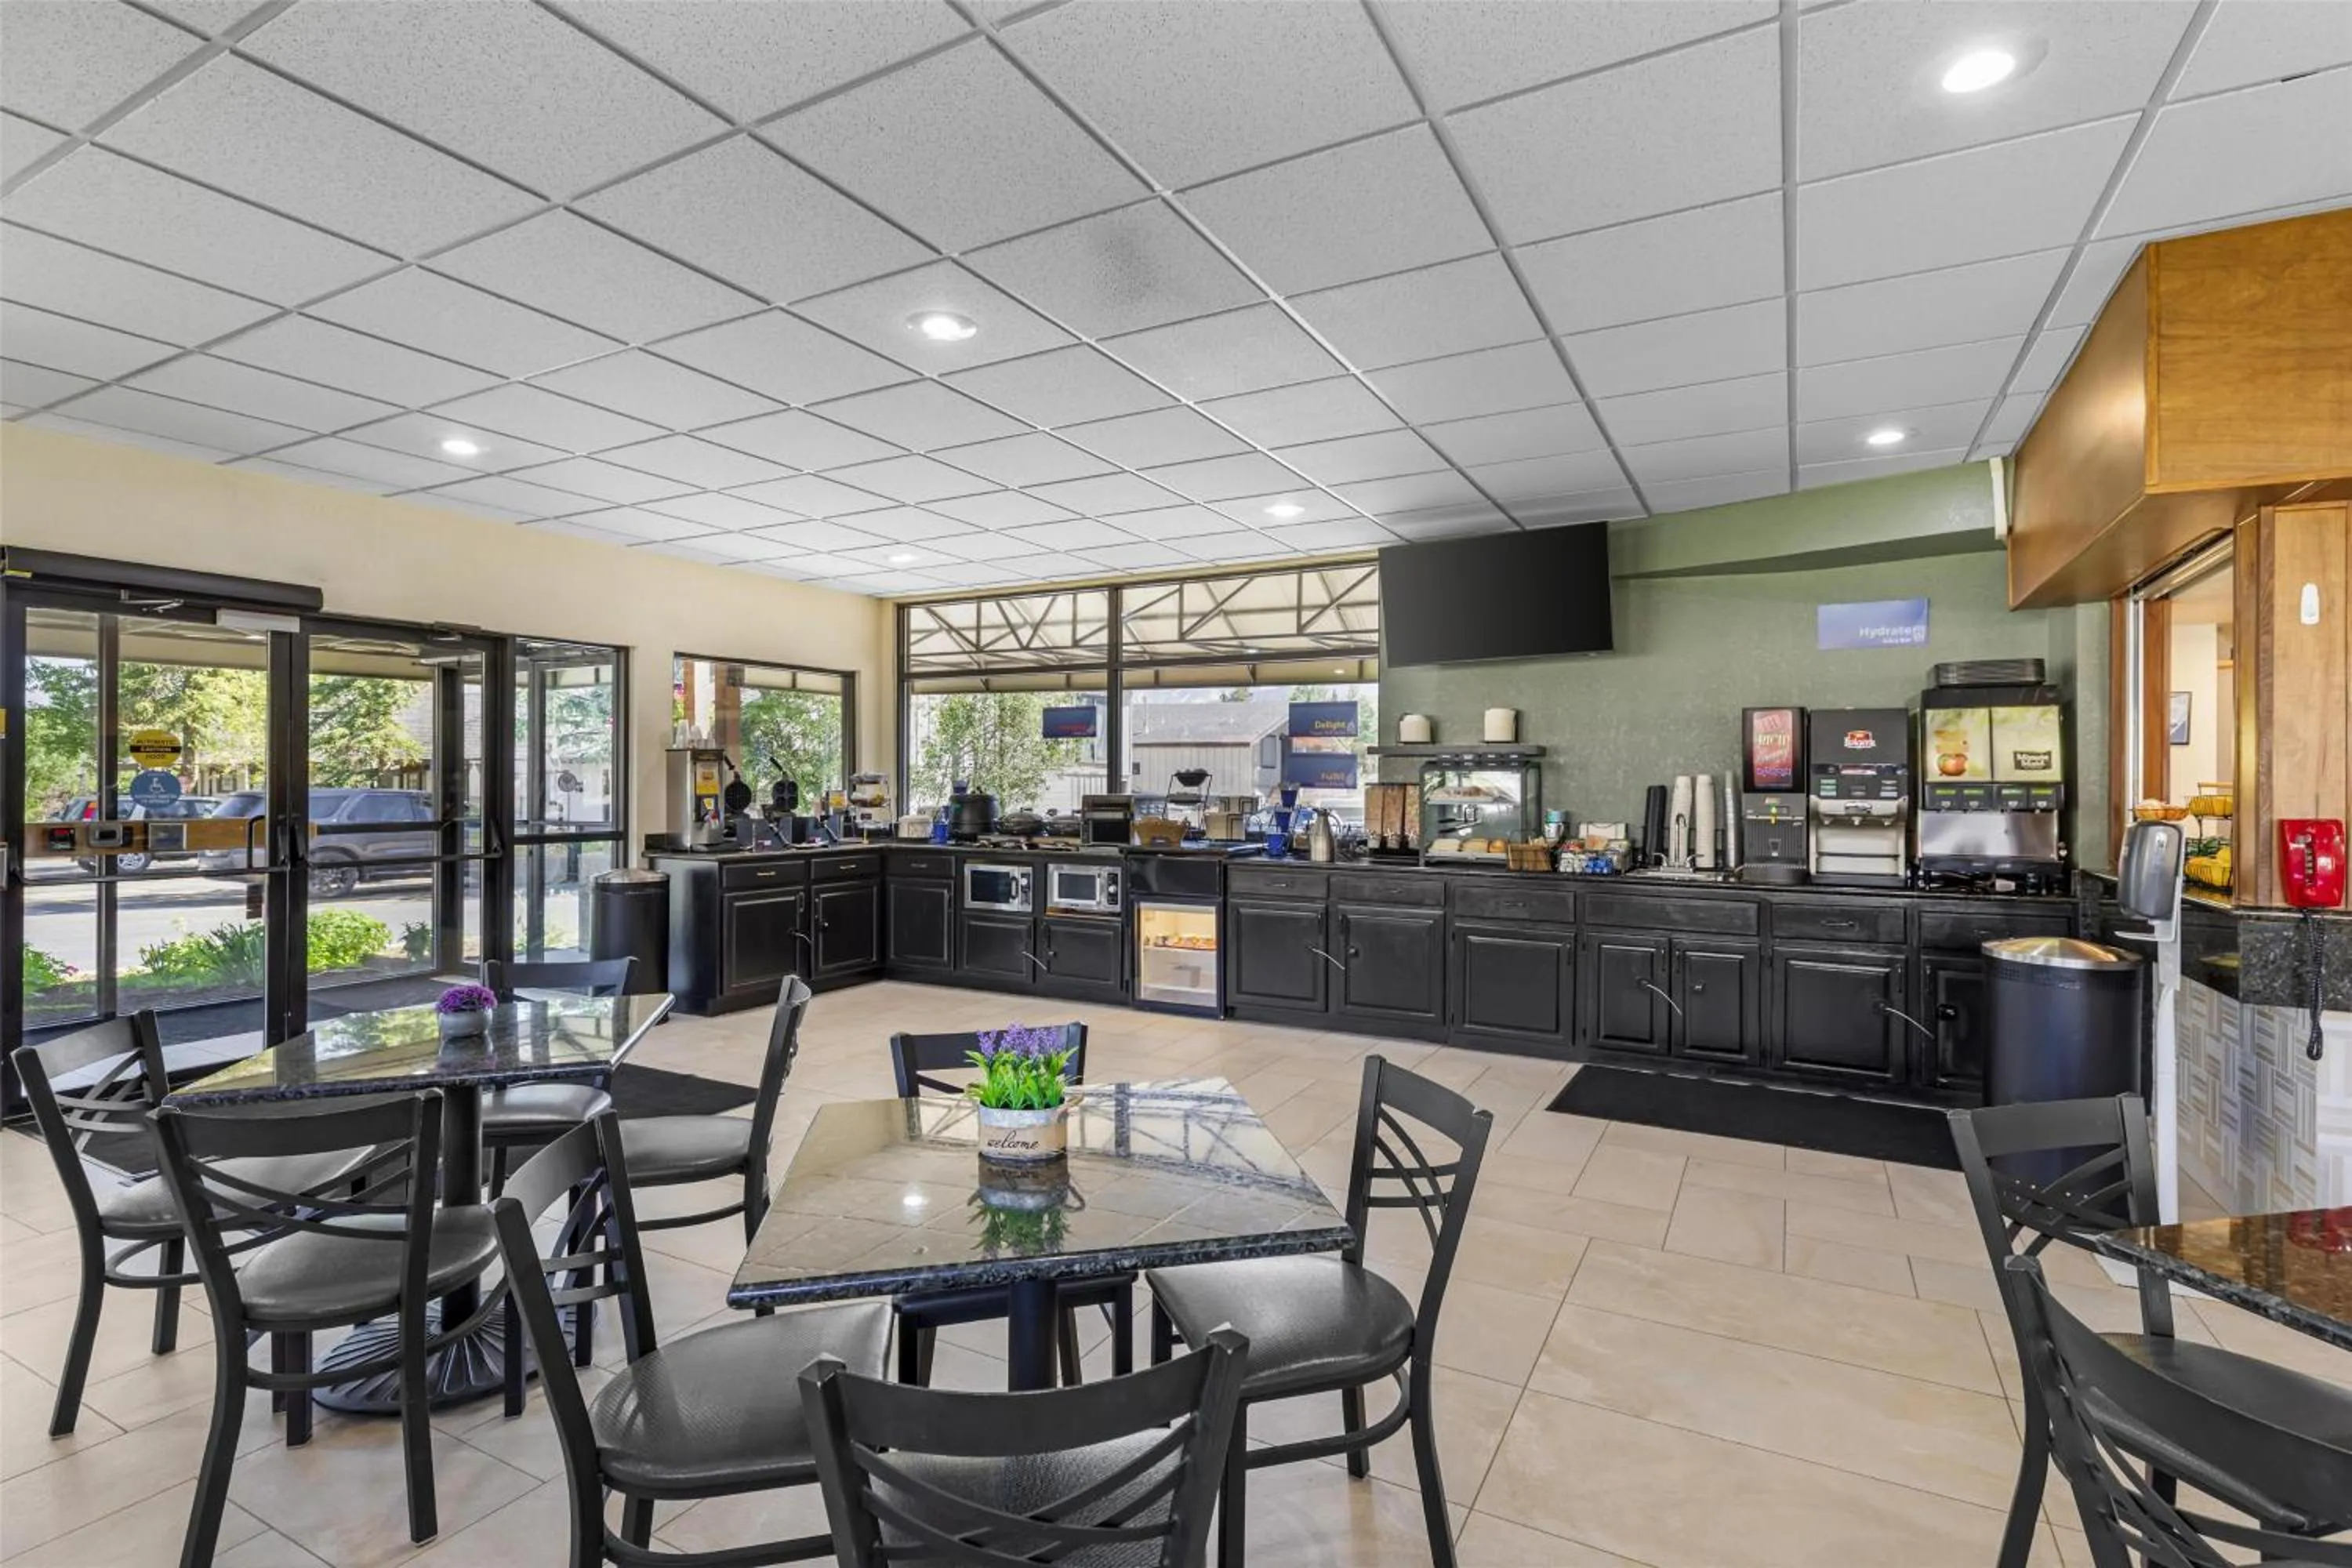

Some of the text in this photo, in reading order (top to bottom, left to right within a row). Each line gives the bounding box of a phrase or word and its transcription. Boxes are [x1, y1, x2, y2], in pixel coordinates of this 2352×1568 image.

[1858, 626, 1911, 639] Hydrate
[1314, 720, 1346, 730] Delight
[987, 1130, 1040, 1150] welcome
